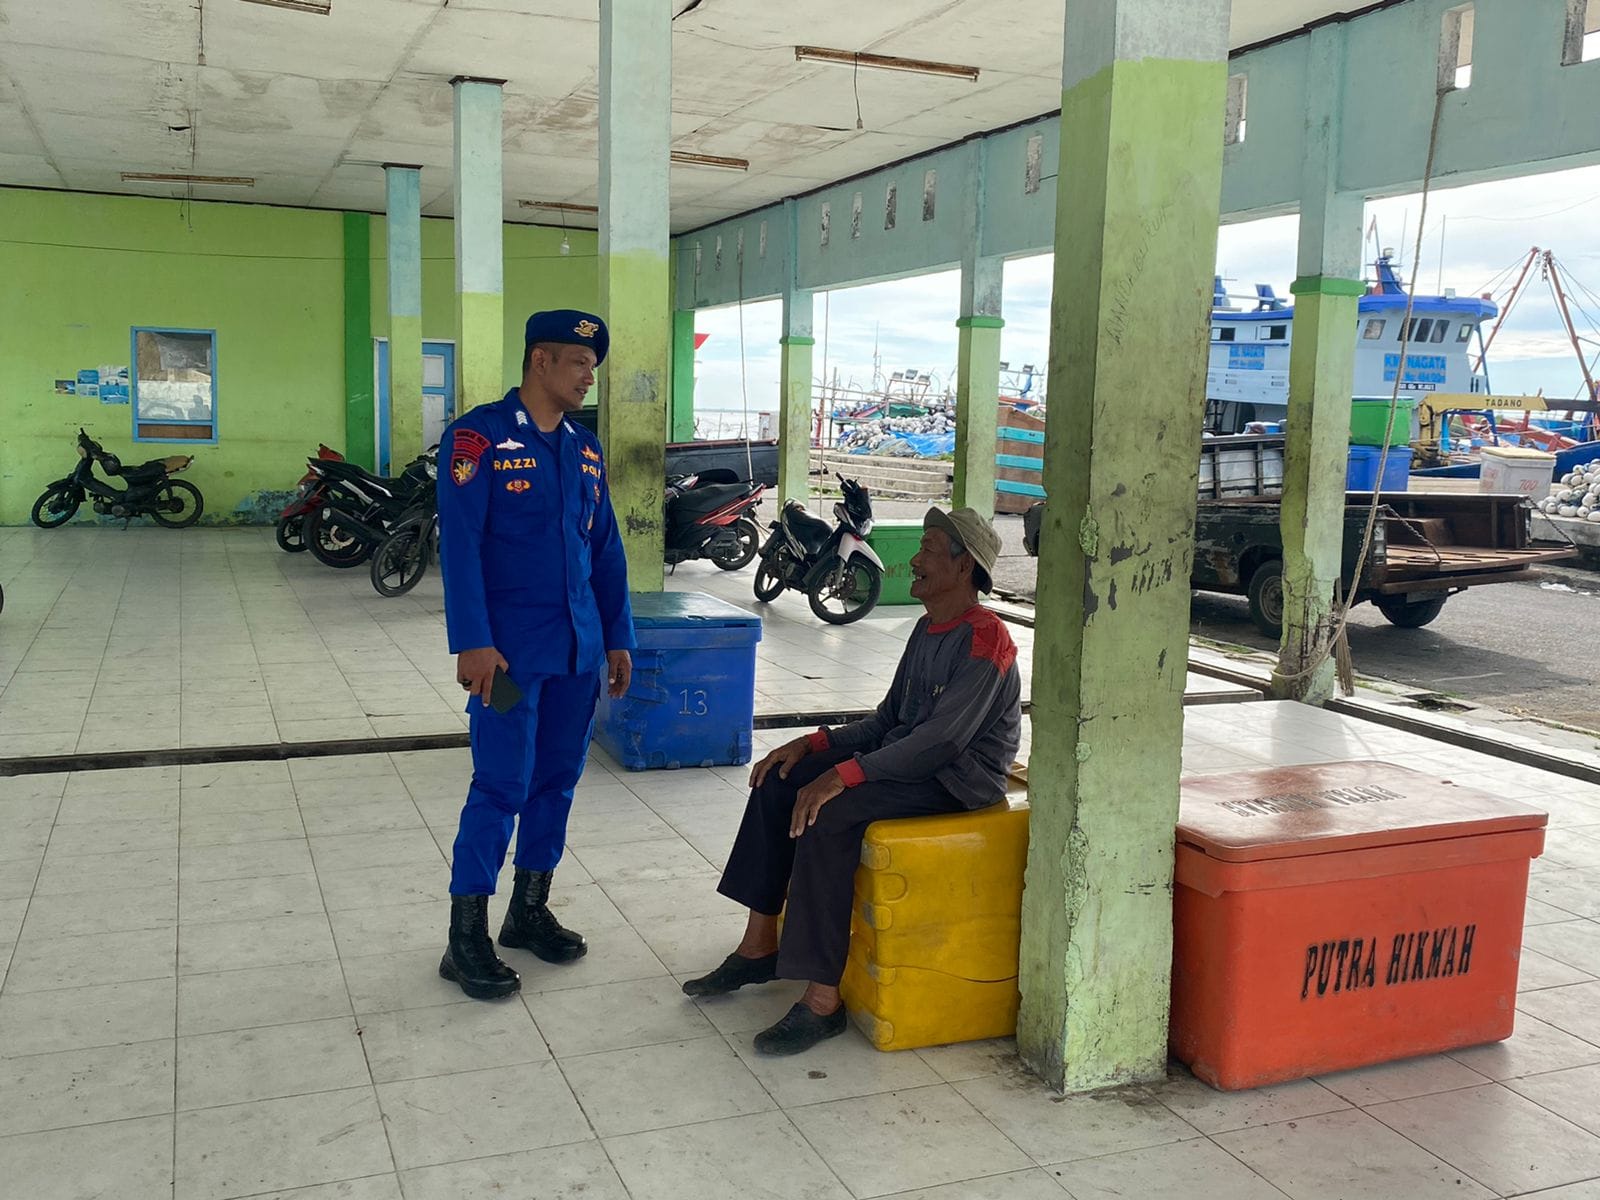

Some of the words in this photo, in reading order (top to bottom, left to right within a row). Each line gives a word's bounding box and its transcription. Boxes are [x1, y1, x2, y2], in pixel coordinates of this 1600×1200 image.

[1485, 398, 1522, 408] TADANO
[493, 457, 537, 471] RAZZI
[678, 688, 708, 716] 13
[1301, 936, 1377, 1000] PUTRA
[1386, 923, 1477, 986] HIKMAH
